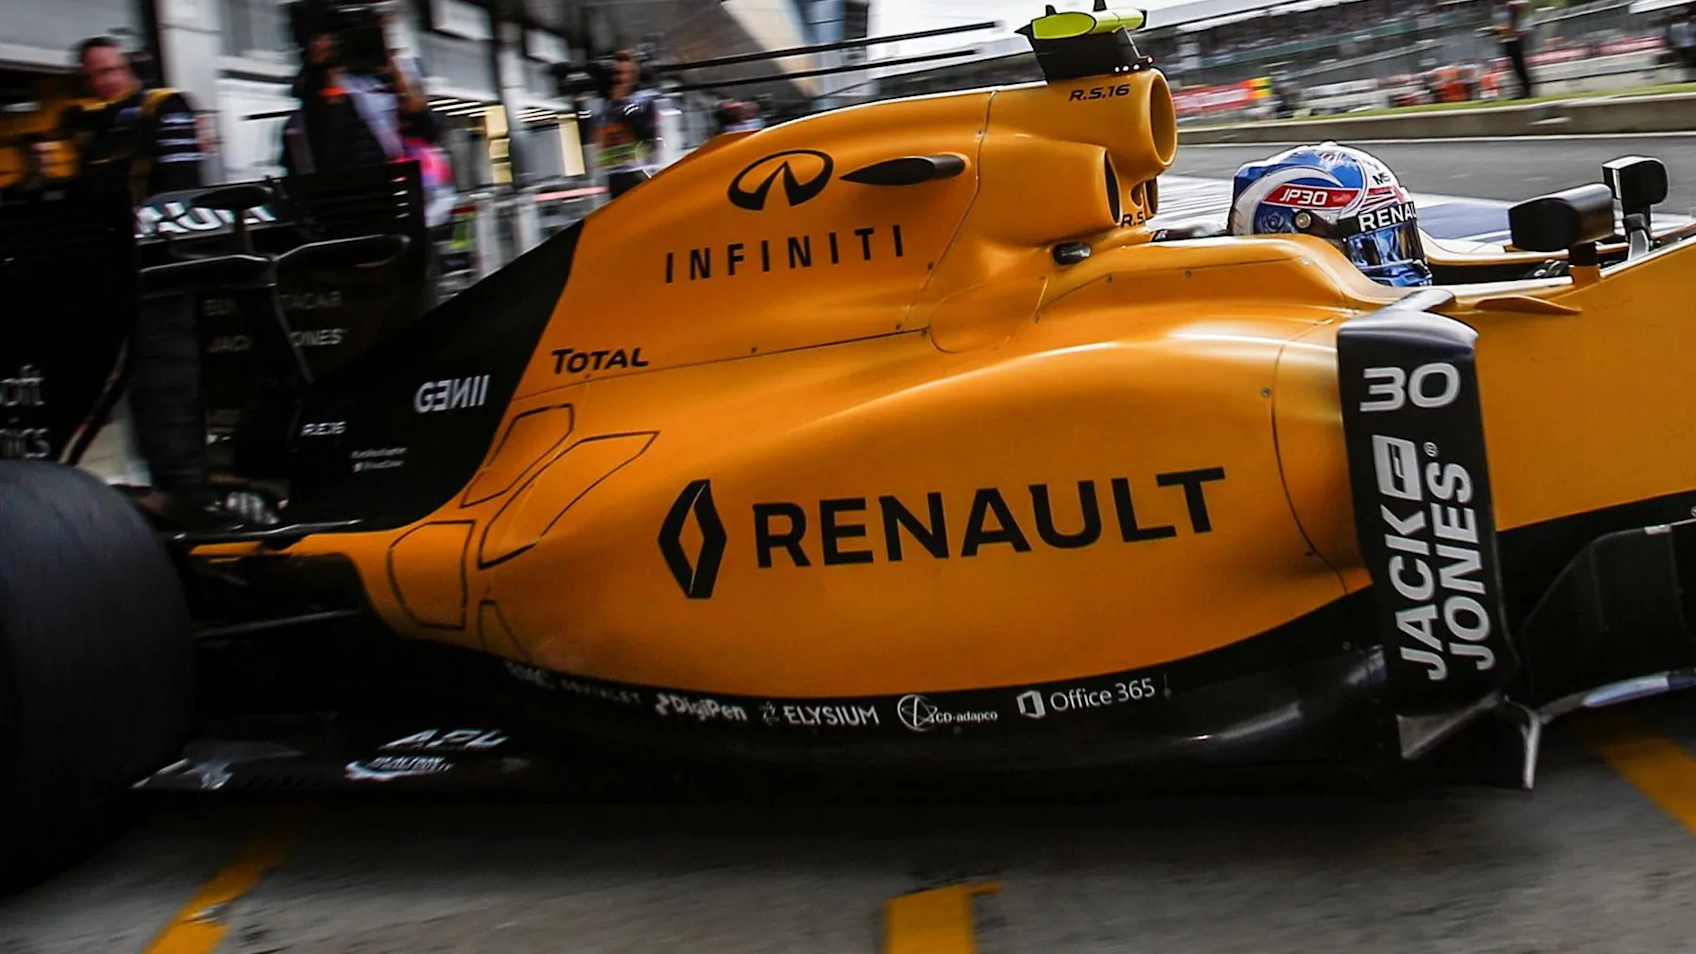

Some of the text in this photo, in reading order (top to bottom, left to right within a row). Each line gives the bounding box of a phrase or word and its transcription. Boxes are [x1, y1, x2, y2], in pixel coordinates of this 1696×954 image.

[1068, 83, 1131, 102] R.S.16
[1279, 188, 1328, 206] JP30
[665, 224, 904, 284] INFINITI
[551, 347, 649, 375] TOTAL
[1359, 362, 1461, 412] 30
[751, 466, 1227, 569] RENAULT
[1380, 503, 1449, 681] JACK
[669, 695, 748, 722] DigiPen
[1049, 677, 1156, 713] Office 365
[783, 704, 881, 726] ELYSIUM
